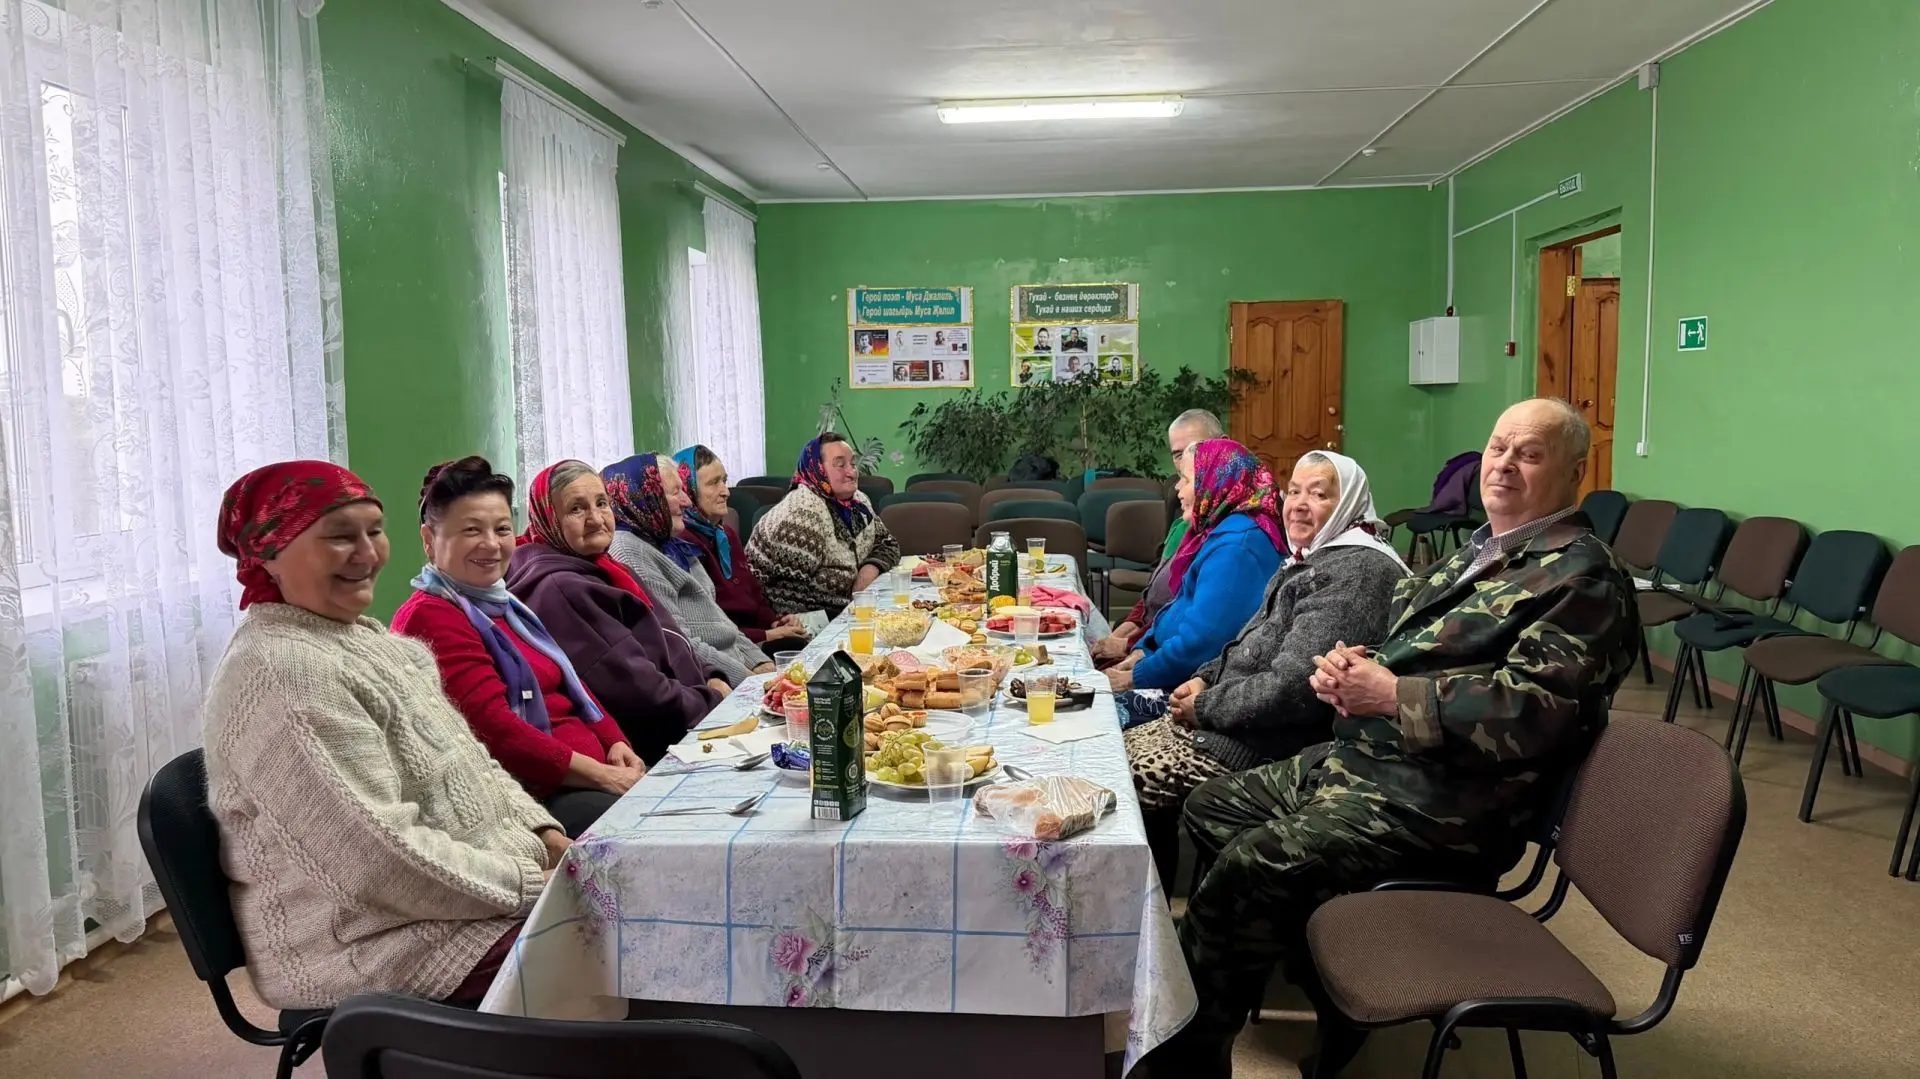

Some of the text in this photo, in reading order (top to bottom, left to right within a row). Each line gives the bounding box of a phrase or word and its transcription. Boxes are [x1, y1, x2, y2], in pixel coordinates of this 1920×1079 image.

[862, 292, 881, 304] Герой
[882, 293, 900, 302] поэт
[905, 291, 922, 304] Муса
[923, 291, 953, 303] Джалиль
[1028, 292, 1047, 304] Тукай
[862, 306, 881, 318] Герой
[914, 305, 931, 318] Муса
[1035, 304, 1054, 316] Тукай
[1061, 305, 1083, 313] наших
[1083, 303, 1112, 315] сердцах
[989, 559, 1001, 592] Добрый
